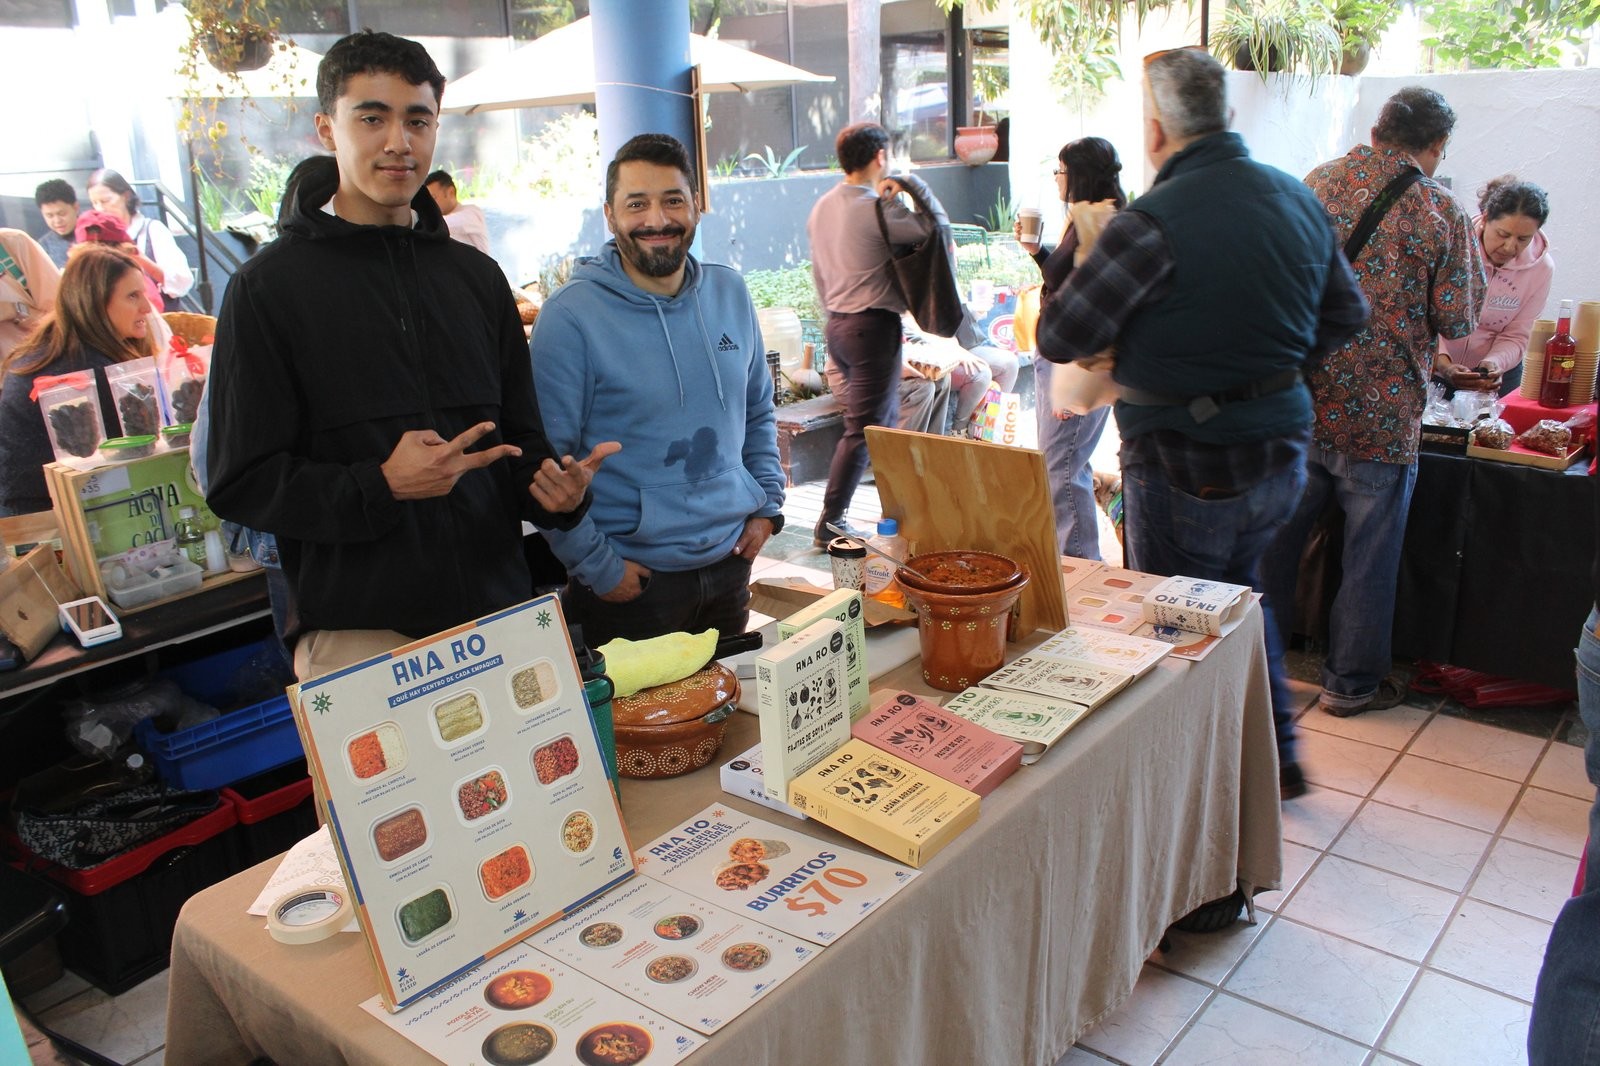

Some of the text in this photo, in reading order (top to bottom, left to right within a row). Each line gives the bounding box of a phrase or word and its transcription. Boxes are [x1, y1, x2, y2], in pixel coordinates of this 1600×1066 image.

[1155, 594, 1179, 604] RO
[1186, 599, 1217, 612] ANA
[391, 631, 488, 686] ANA RO
[796, 646, 828, 673] ANA RO
[1012, 658, 1032, 668] RO
[391, 656, 500, 705] ¿QUÉ HAY DENTRO DE CADA EMPAQUE?
[870, 705, 902, 728] ANA RO
[818, 754, 853, 777] ANA RO
[649, 819, 710, 856] ANA RO
[660, 821, 727, 863] MENU FERIA DE
[669, 825, 733, 865] PRODUCTORES
[746, 851, 837, 912] BURRITOS
[783, 867, 868, 918] $70
